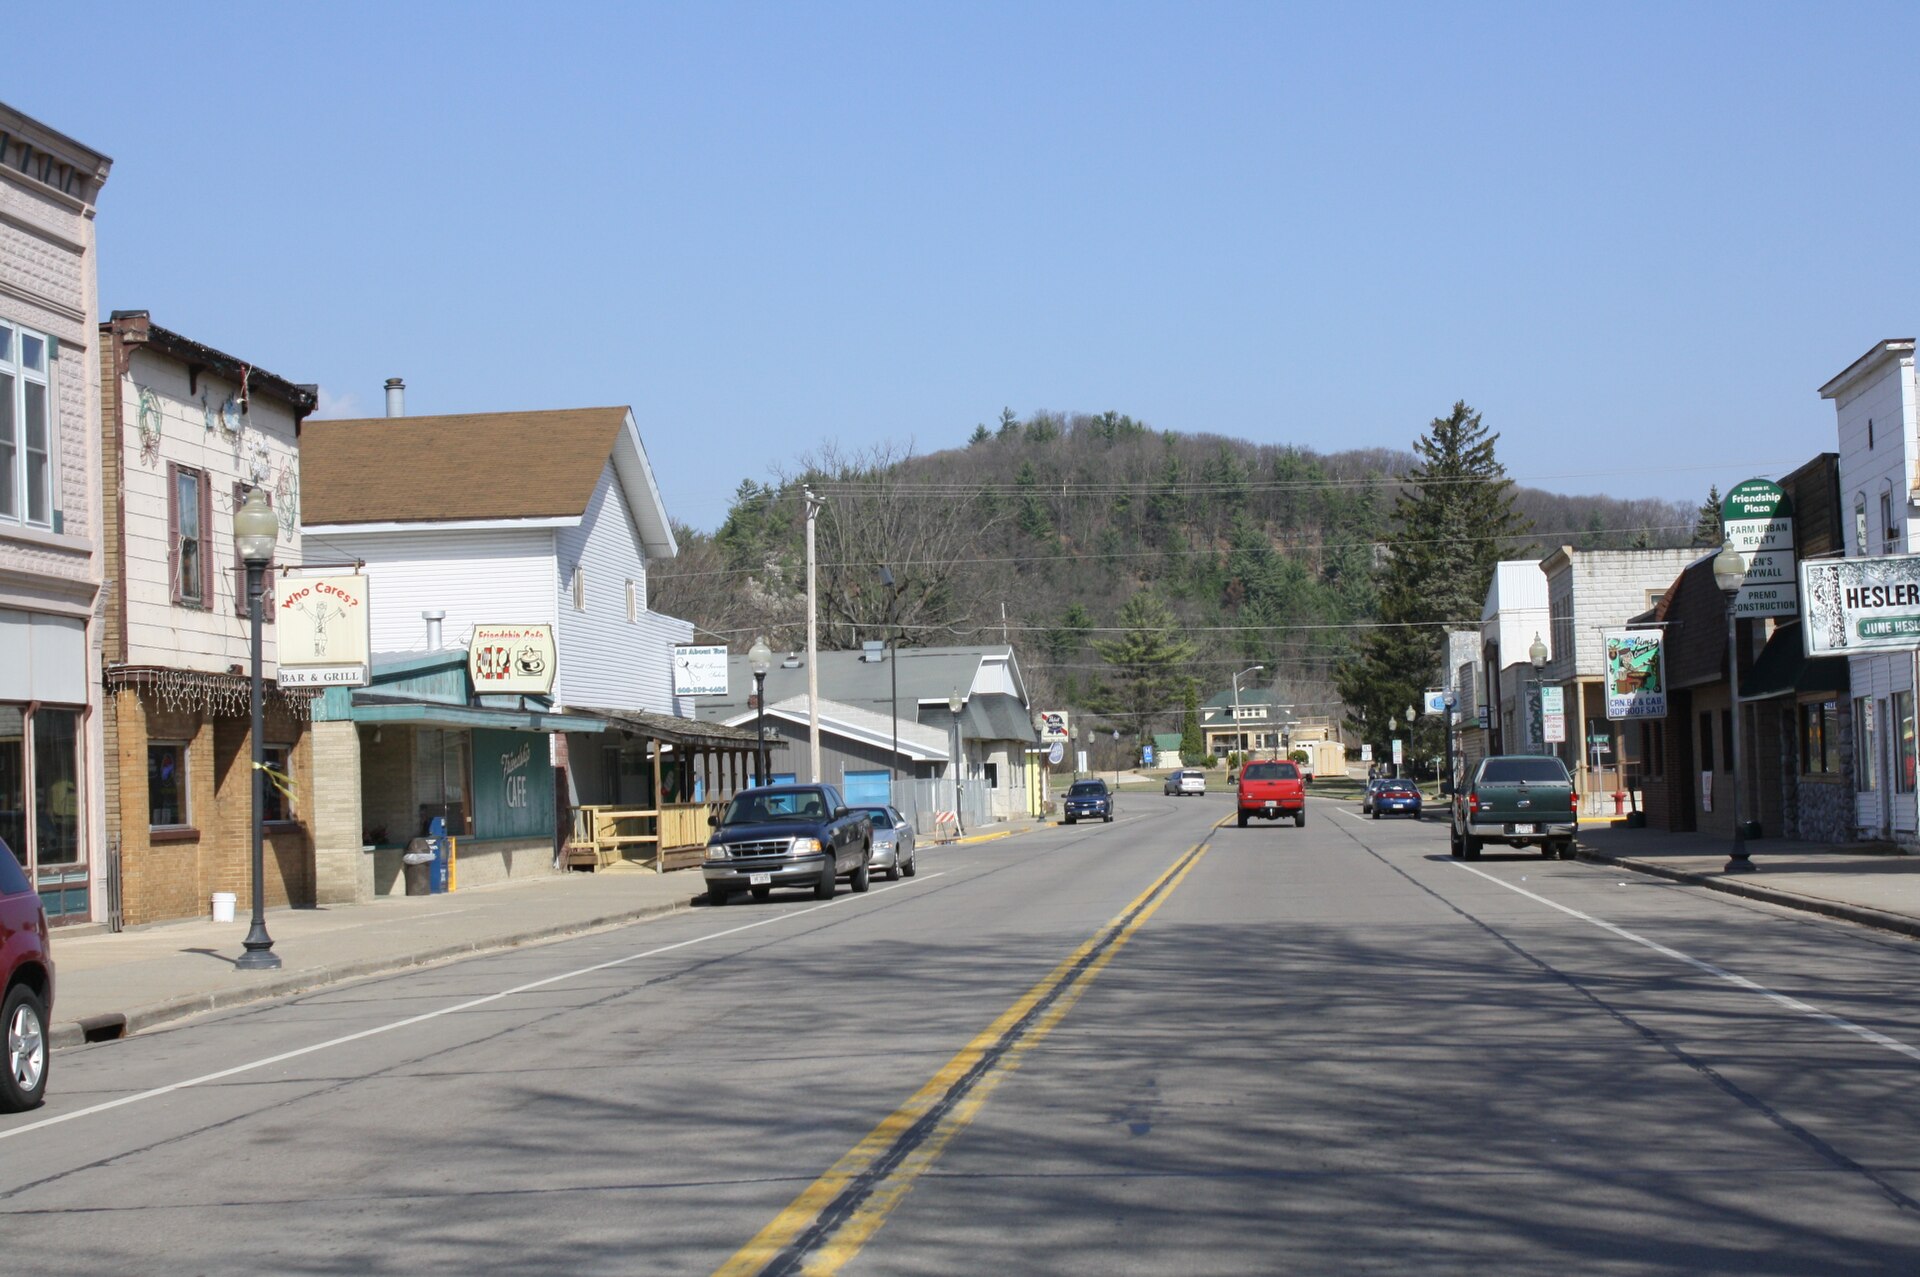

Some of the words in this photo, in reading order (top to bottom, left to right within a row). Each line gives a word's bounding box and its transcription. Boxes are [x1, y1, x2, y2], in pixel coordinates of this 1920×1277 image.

[1732, 492, 1781, 504] Friendship
[1743, 504, 1771, 513] Plaza
[1730, 525, 1755, 535] FARM
[1757, 523, 1788, 533] URBAN
[1743, 535, 1776, 545] REALTY
[1748, 556, 1773, 567] LEN'S
[281, 587, 310, 610] Who
[315, 582, 359, 608] Cares?
[1748, 590, 1777, 600] PREMO
[1846, 584, 1920, 609] HESLER
[1864, 622, 1892, 634] JUNE
[688, 647, 711, 655] About
[281, 673, 305, 683] BAR
[310, 673, 318, 682] &
[323, 672, 359, 682] GRILL
[1543, 687, 1549, 696] 2
[1638, 698, 1644, 706] &
[506, 775, 527, 808] CAFE
